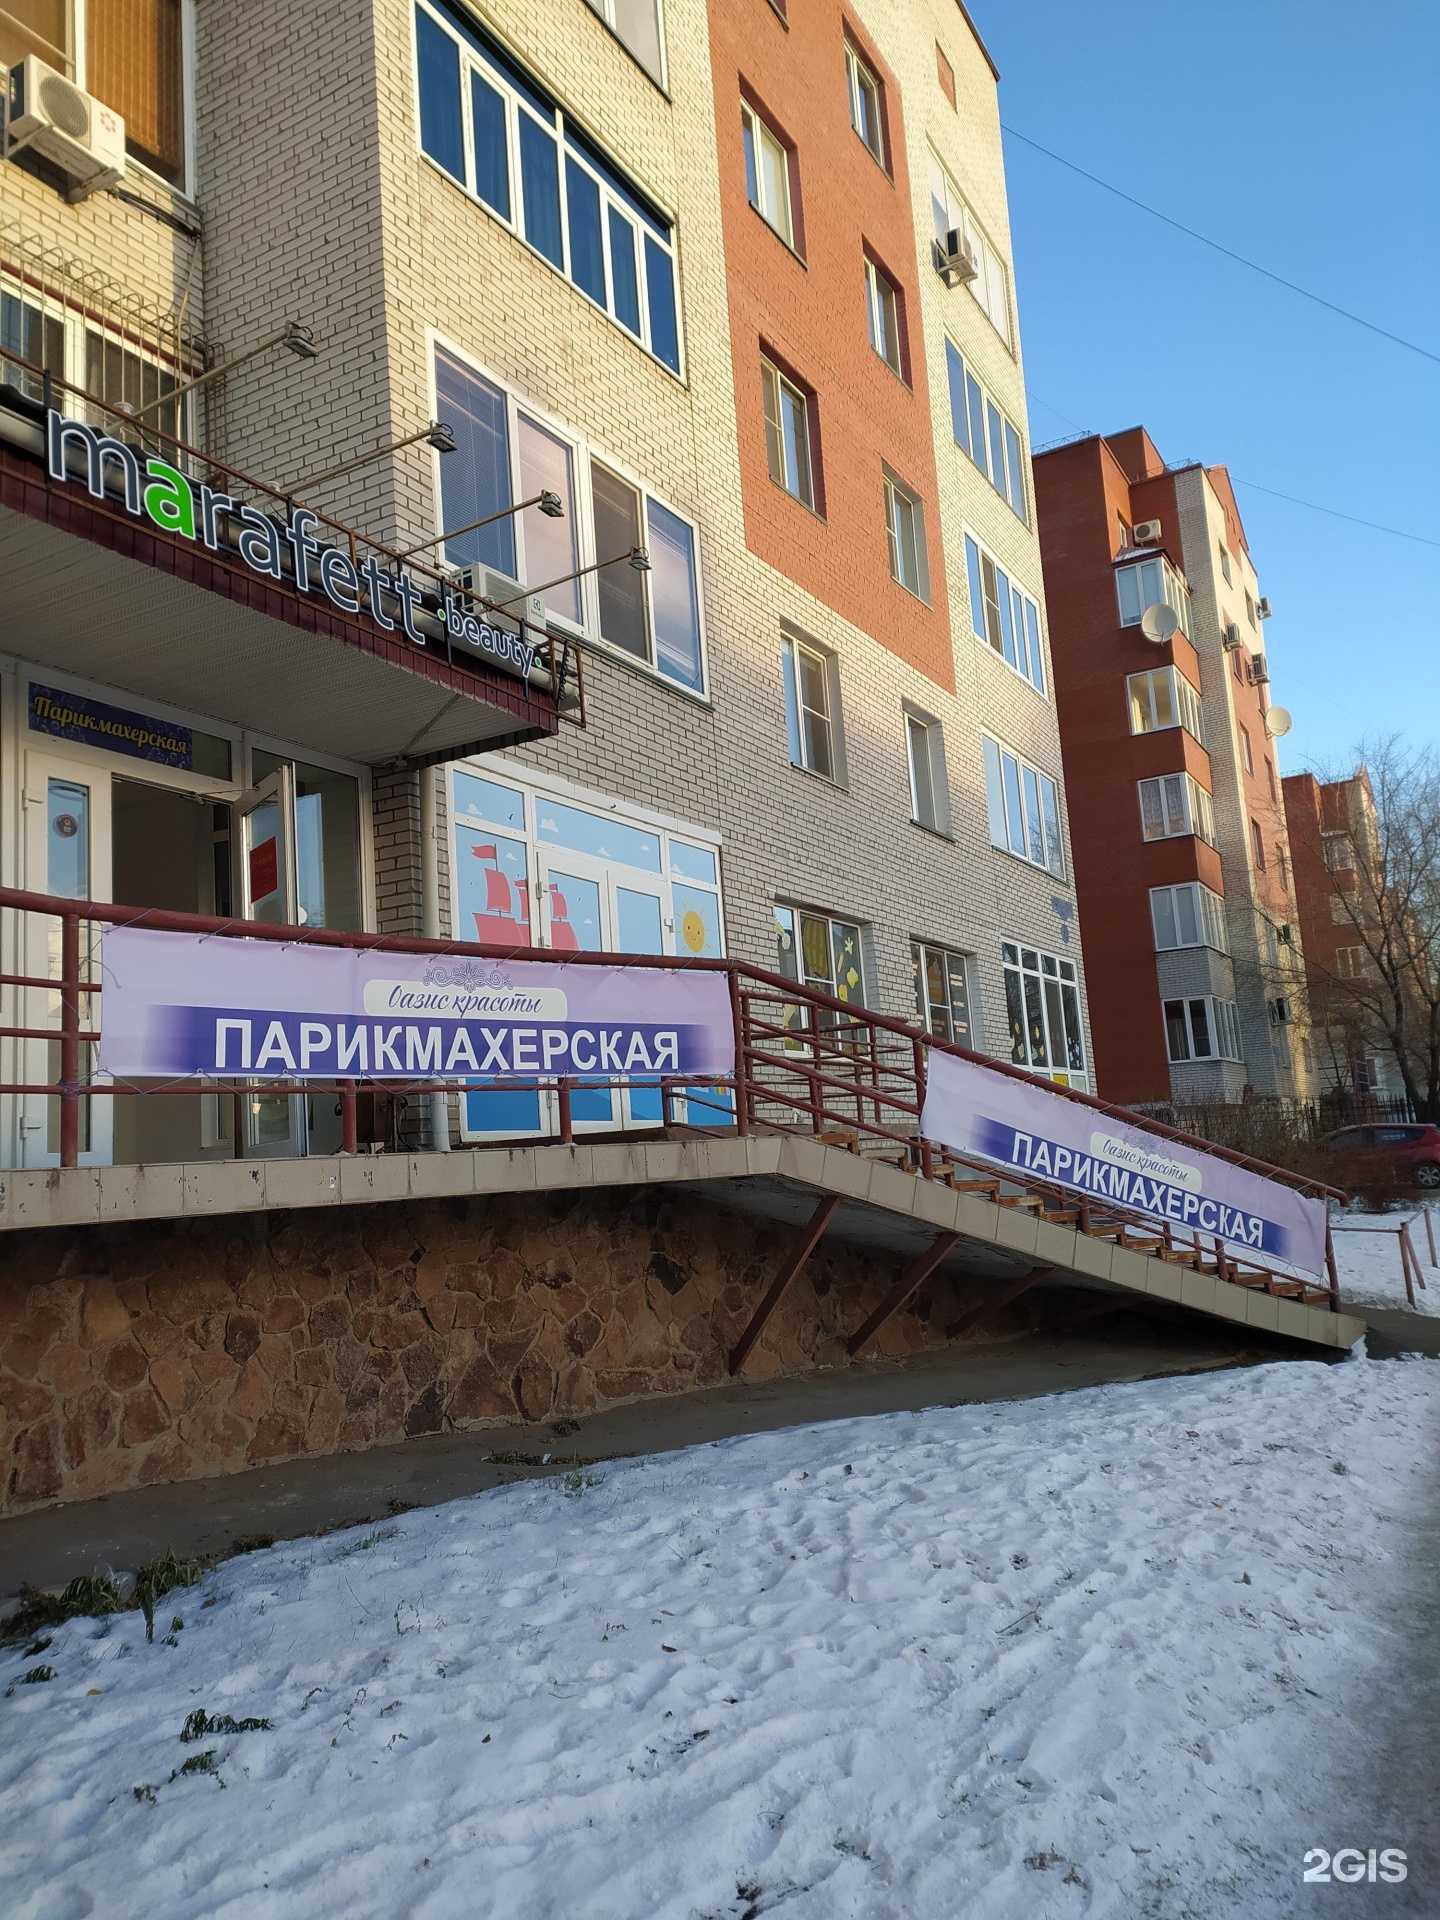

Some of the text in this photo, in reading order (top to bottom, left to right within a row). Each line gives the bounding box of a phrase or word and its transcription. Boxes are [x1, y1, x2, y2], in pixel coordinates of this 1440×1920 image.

[48, 407, 426, 646] marafett
[32, 694, 189, 756] Парикмахерская
[388, 984, 544, 1019] Оазис красоты
[214, 1017, 680, 1073] ПАРИКМАХЕРСКАЯ
[1011, 1130, 1264, 1249] ПАРИКМАХЕРСКАЯ
[1102, 1139, 1189, 1182] Оазис красоты
